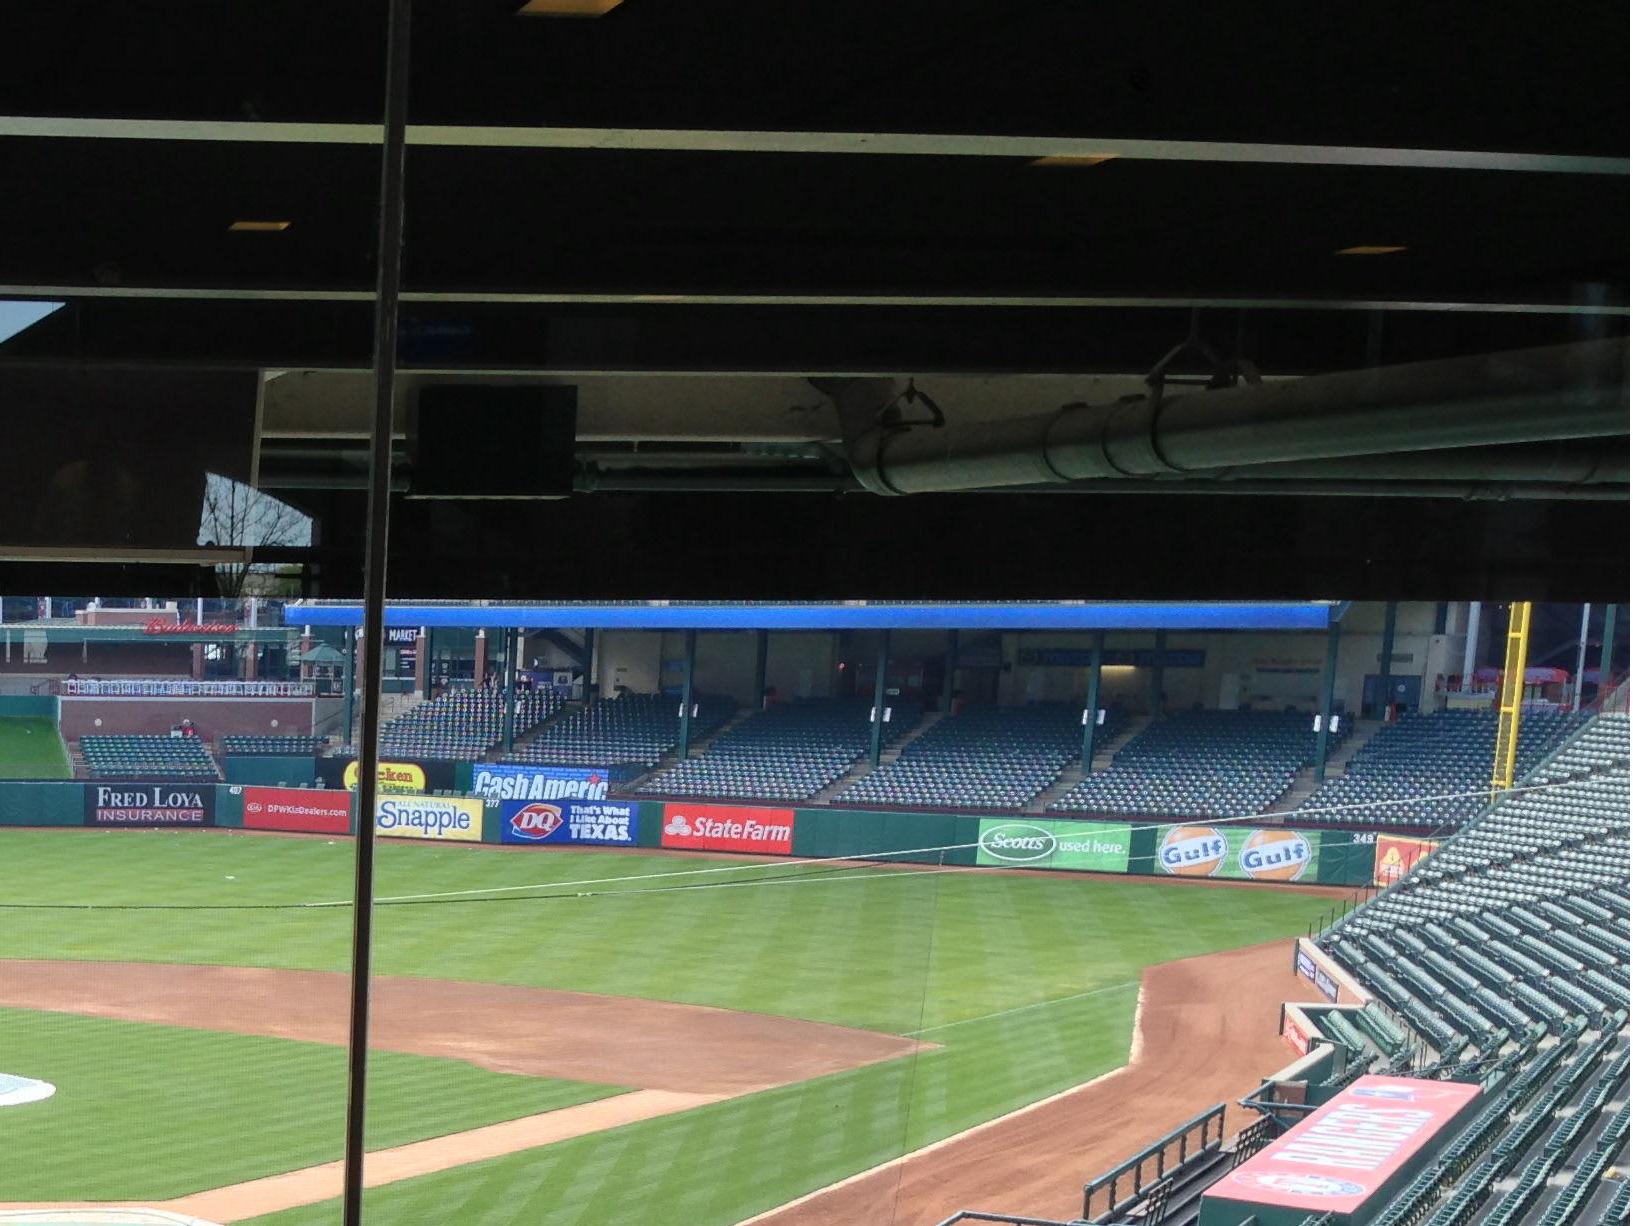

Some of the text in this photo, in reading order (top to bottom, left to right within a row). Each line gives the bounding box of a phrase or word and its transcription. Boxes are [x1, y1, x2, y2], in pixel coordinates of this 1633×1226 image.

[97, 786, 204, 808] FRED LOYA
[97, 809, 203, 821] INSURANCE
[376, 801, 471, 836] Snapple
[519, 811, 556, 832] DQ
[570, 805, 630, 816] That's What
[576, 815, 597, 824] Like
[597, 815, 630, 825] About
[990, 832, 1127, 855] Scotts used here.
[1164, 839, 1224, 865] Gulf
[1242, 843, 1305, 869] Gulf
